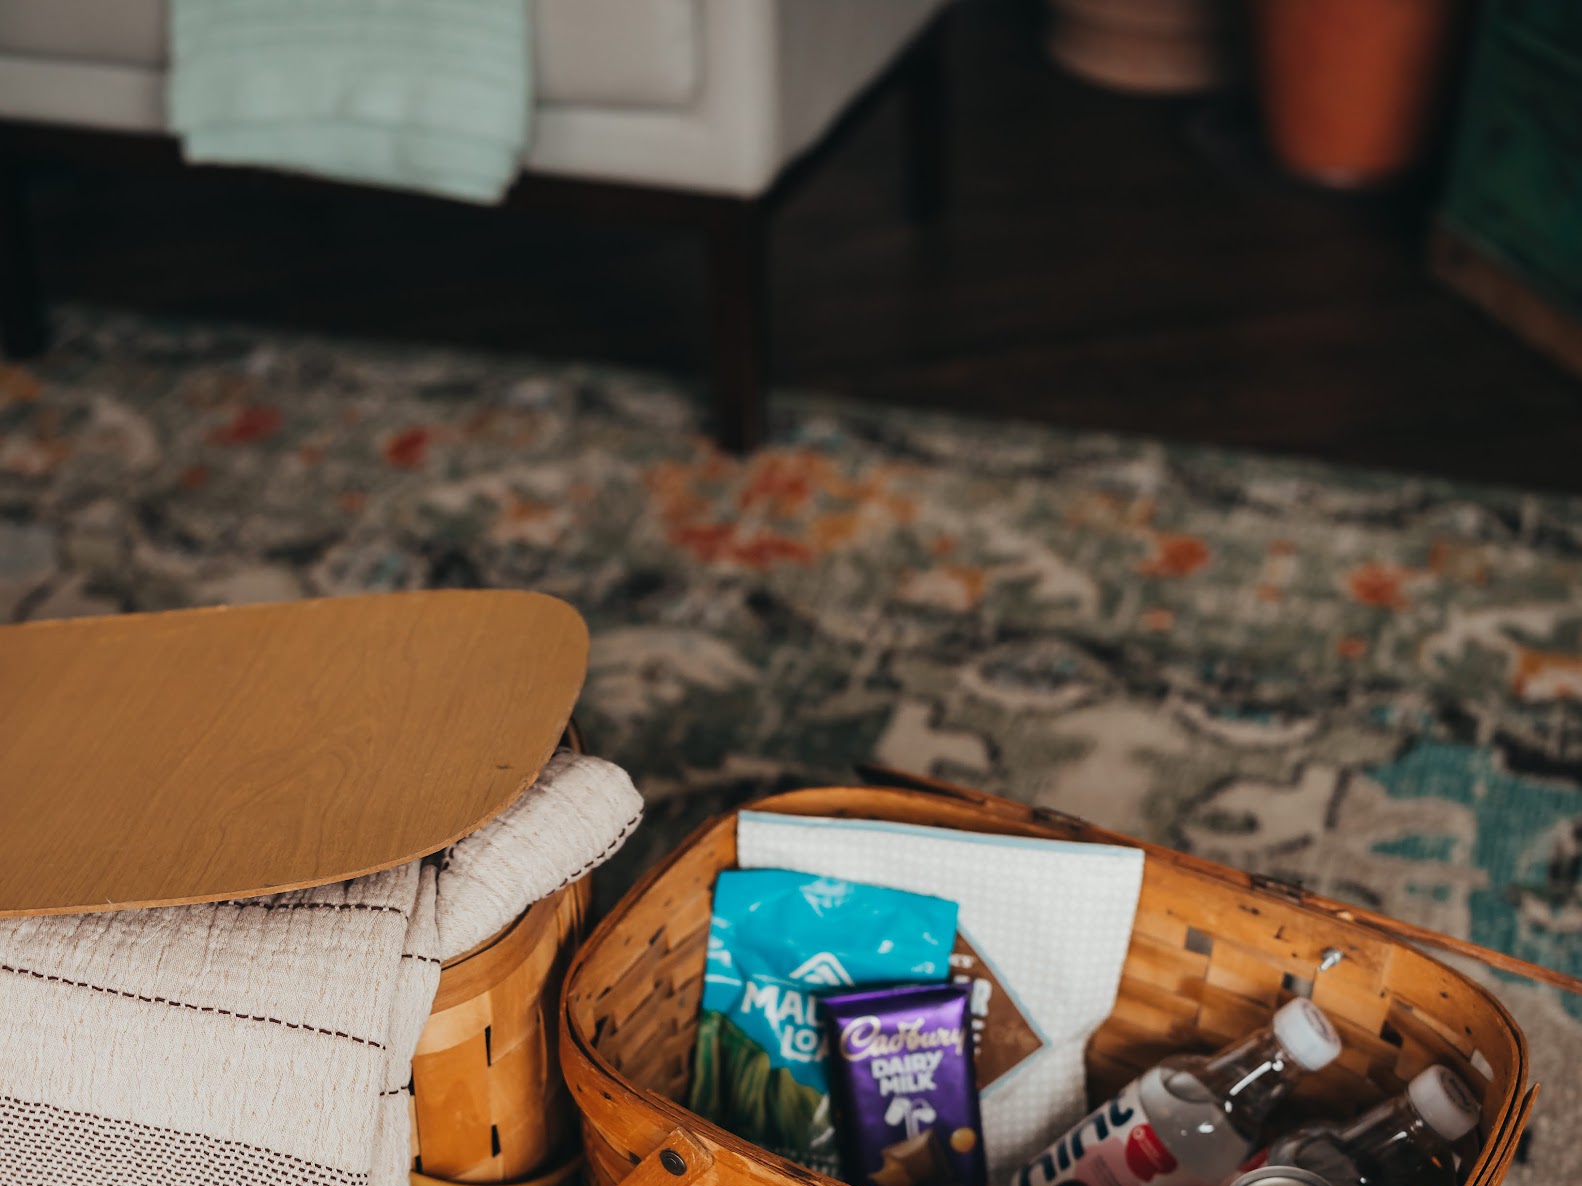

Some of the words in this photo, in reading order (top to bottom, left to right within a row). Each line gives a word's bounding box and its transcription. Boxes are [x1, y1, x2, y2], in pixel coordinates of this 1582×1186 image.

[840, 1015, 966, 1061] Cadbury
[871, 1050, 944, 1080] DAIRY
[879, 1072, 938, 1096] MILK
